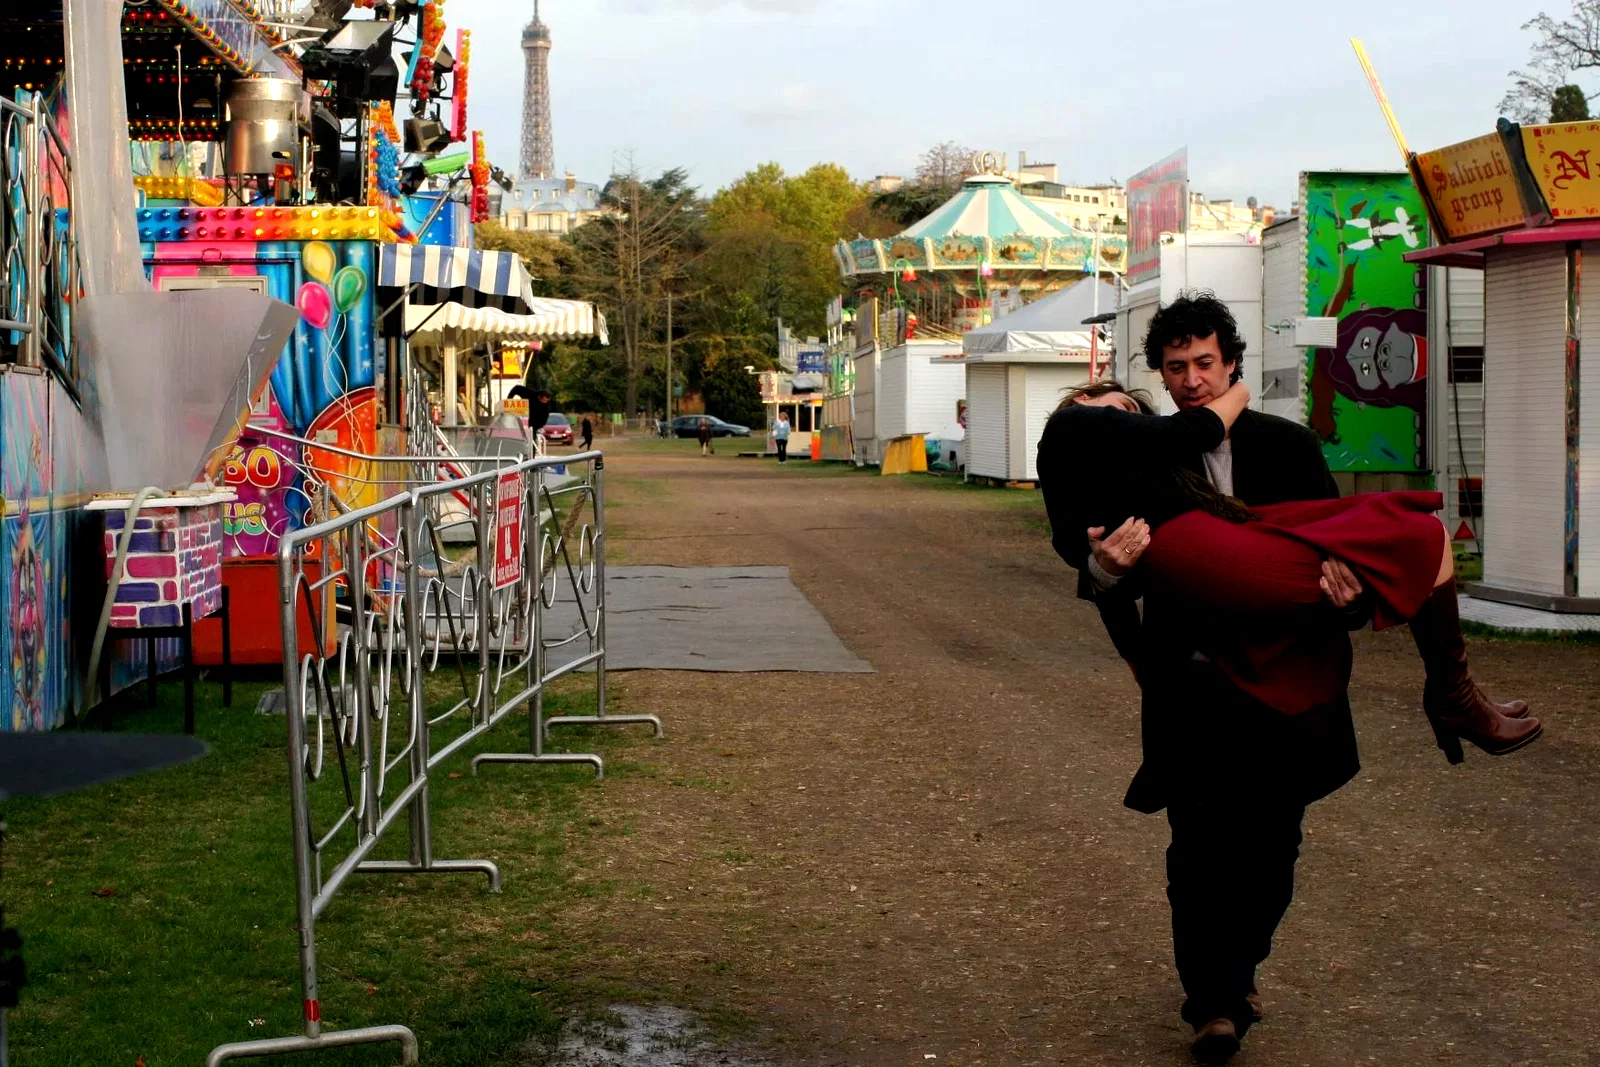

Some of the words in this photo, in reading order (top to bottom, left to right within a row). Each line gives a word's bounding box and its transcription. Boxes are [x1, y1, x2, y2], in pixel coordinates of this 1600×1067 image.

[1431, 150, 1507, 200] Salvioli
[1550, 150, 1600, 190] N
[1451, 187, 1504, 222] group
